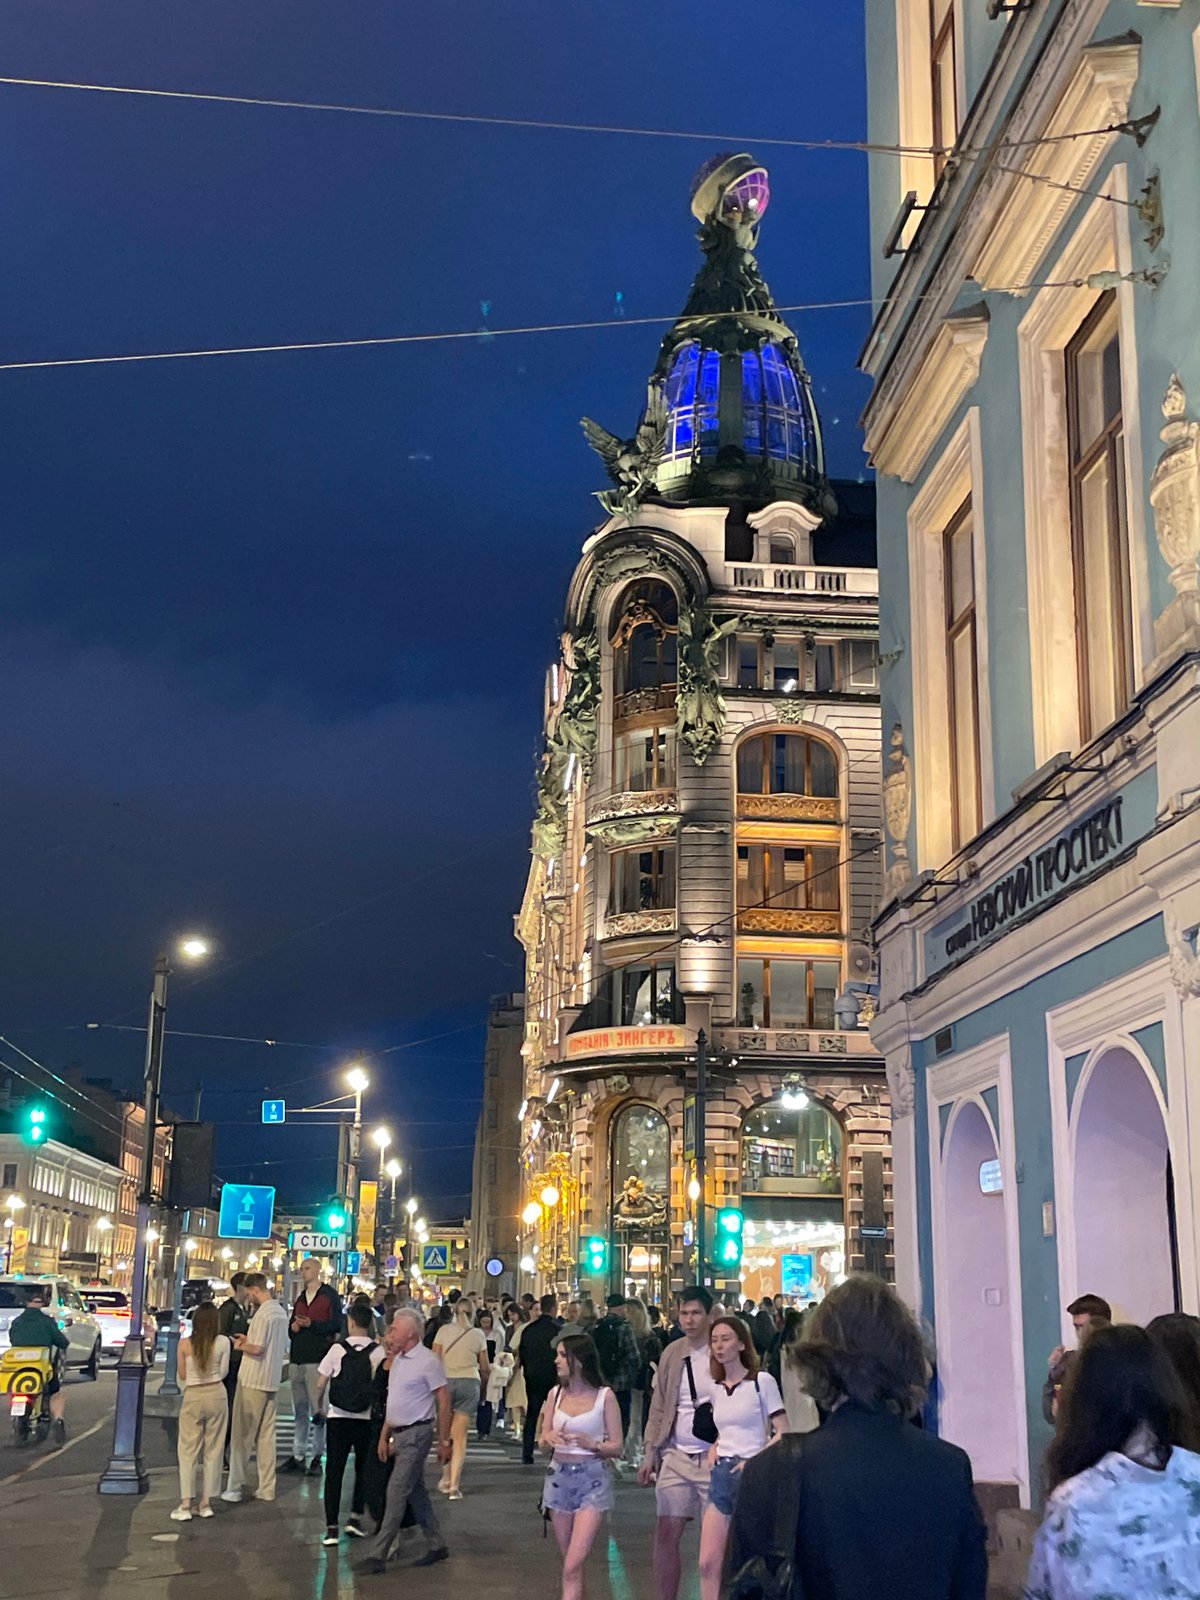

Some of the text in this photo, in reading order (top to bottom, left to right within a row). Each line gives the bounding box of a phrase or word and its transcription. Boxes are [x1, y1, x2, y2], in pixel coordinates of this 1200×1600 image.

[971, 796, 1123, 941] НЕВСКИЙ ПРОСПЕКТ
[616, 1030, 675, 1047] ЗИНГЕРЪ
[301, 1235, 338, 1248] СТОП
